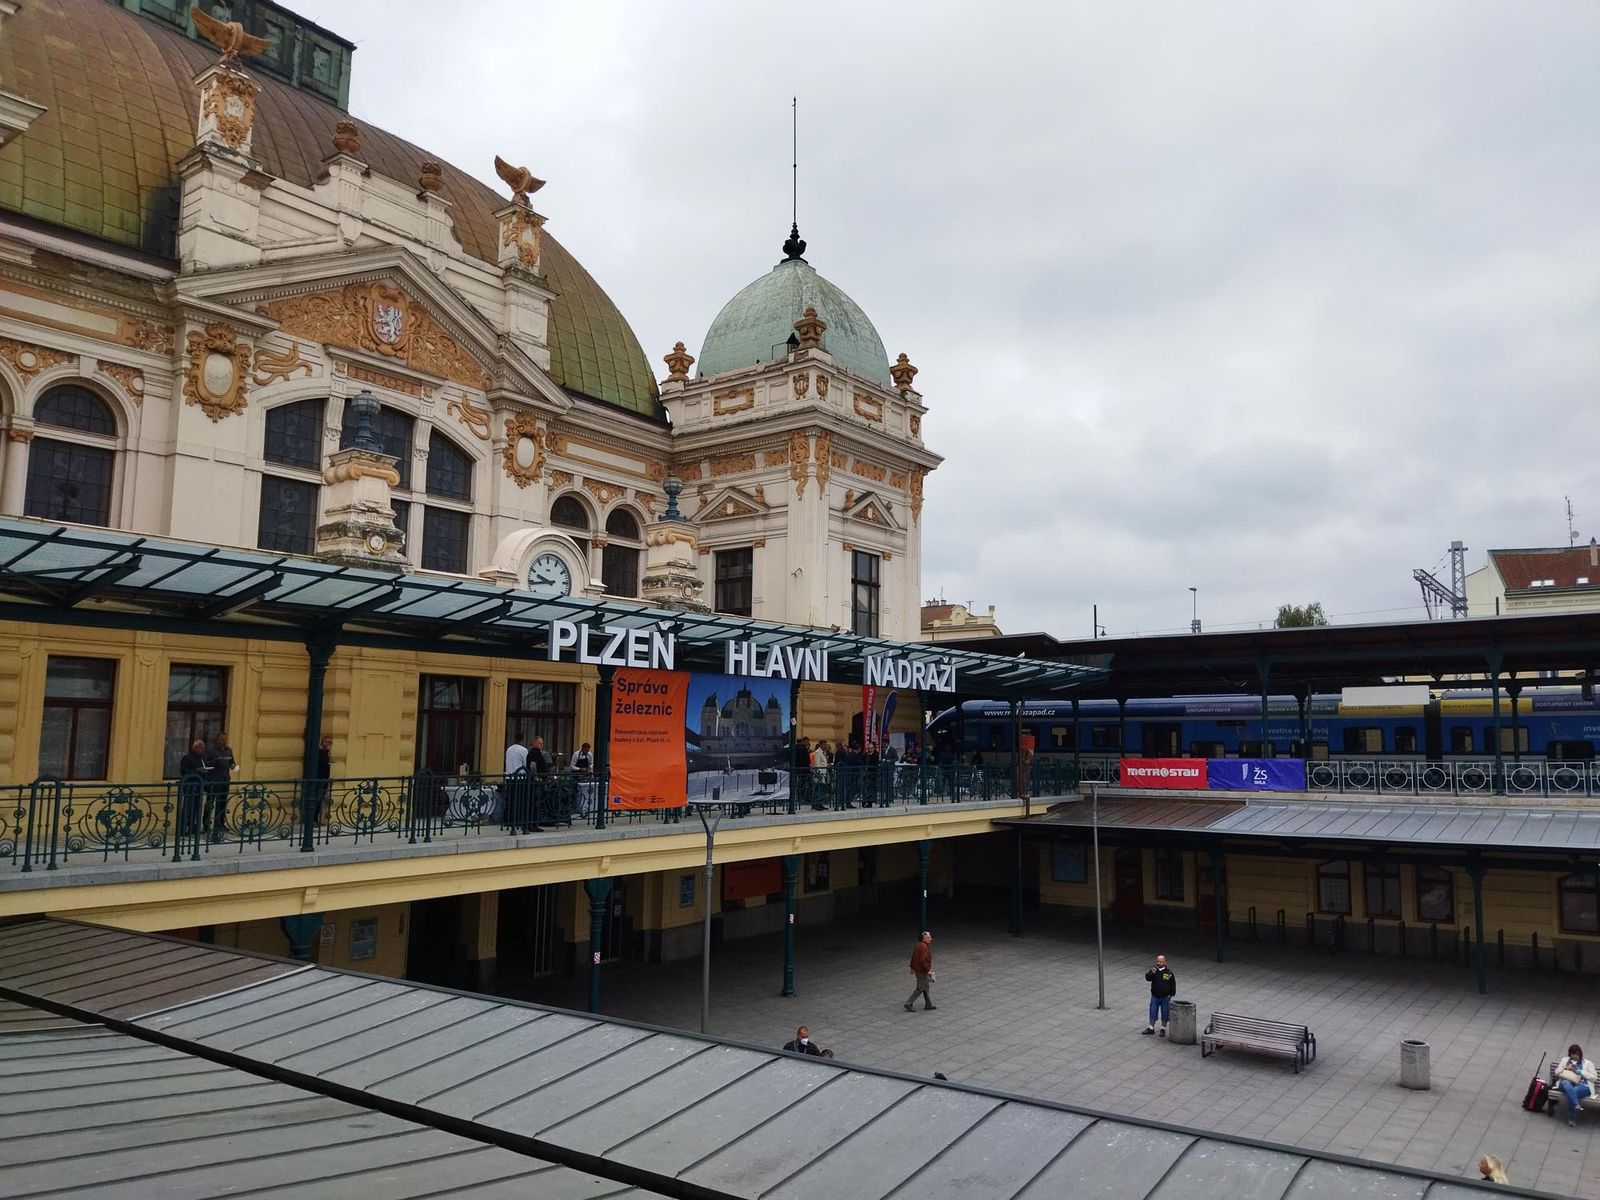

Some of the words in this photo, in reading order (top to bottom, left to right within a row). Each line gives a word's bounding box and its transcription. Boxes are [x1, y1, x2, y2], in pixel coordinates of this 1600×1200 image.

[549, 620, 675, 670] PLZEŇ
[726, 640, 829, 681] HLAVNÍ
[864, 650, 956, 693] NÁDRAŽÍ
[618, 678, 667, 695] Správa
[616, 699, 672, 715] železnic
[1253, 766, 1268, 780] ŽS
